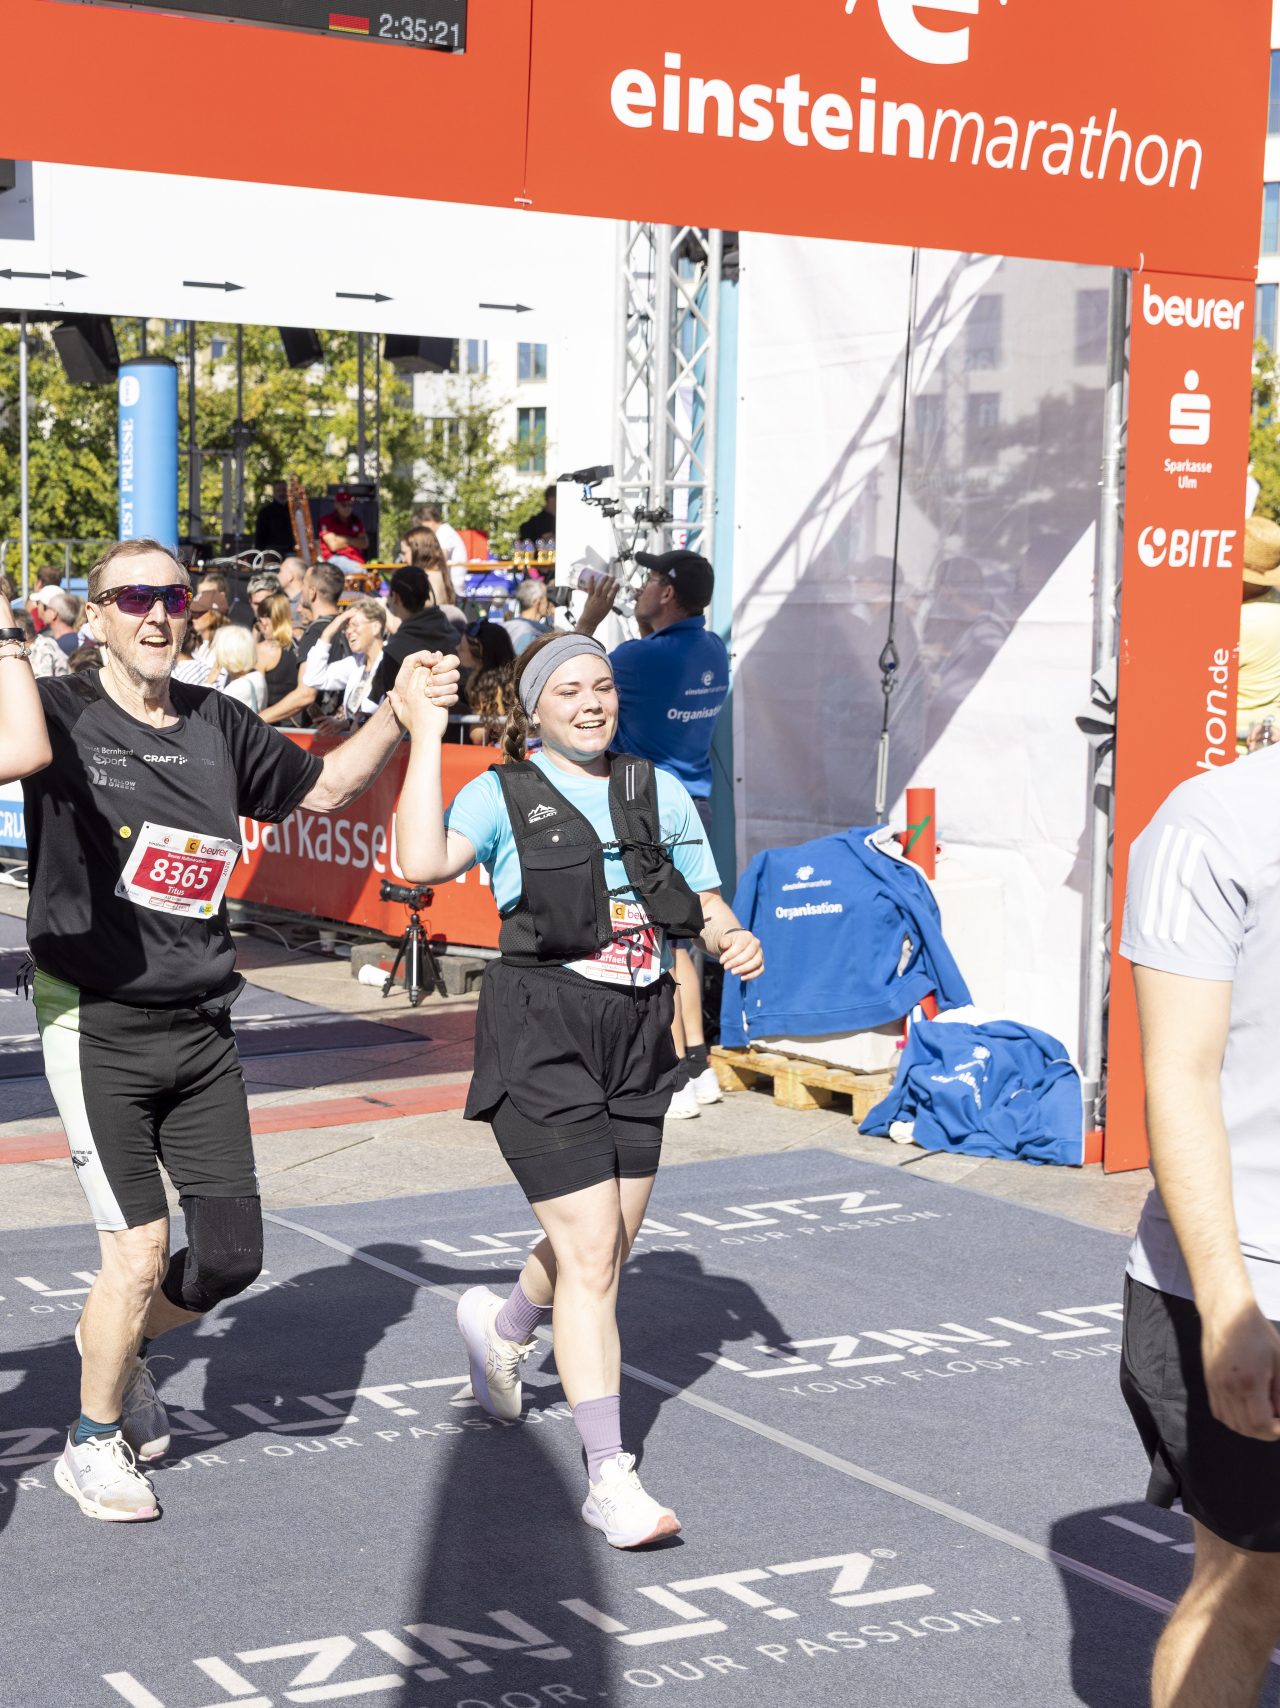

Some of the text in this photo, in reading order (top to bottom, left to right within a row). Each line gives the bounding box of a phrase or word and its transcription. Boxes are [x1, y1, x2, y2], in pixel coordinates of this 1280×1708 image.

[378, 13, 459, 46] 2:35:21
[610, 52, 1203, 190] einsteinmarathon
[1143, 283, 1244, 330] beurer
[122, 418, 134, 493] PRESSE
[1164, 458, 1213, 474] Sparkasse
[1178, 475, 1197, 489] Ulm
[1168, 528, 1237, 568] BITE
[93, 752, 128, 767] Sport
[143, 754, 179, 763] CRAFT
[200, 844, 228, 857] beurer
[149, 858, 213, 890] 8365
[167, 886, 185, 896] Titus
[627, 909, 655, 920] beure
[775, 901, 843, 921] Organisation
[778, 1375, 898, 1398] YOUR
[902, 1355, 1046, 1382] FLOOR.
[262, 1435, 360, 1458] OUR
[622, 1653, 748, 1689] OUR
[755, 1607, 1022, 1664] PASSION.
